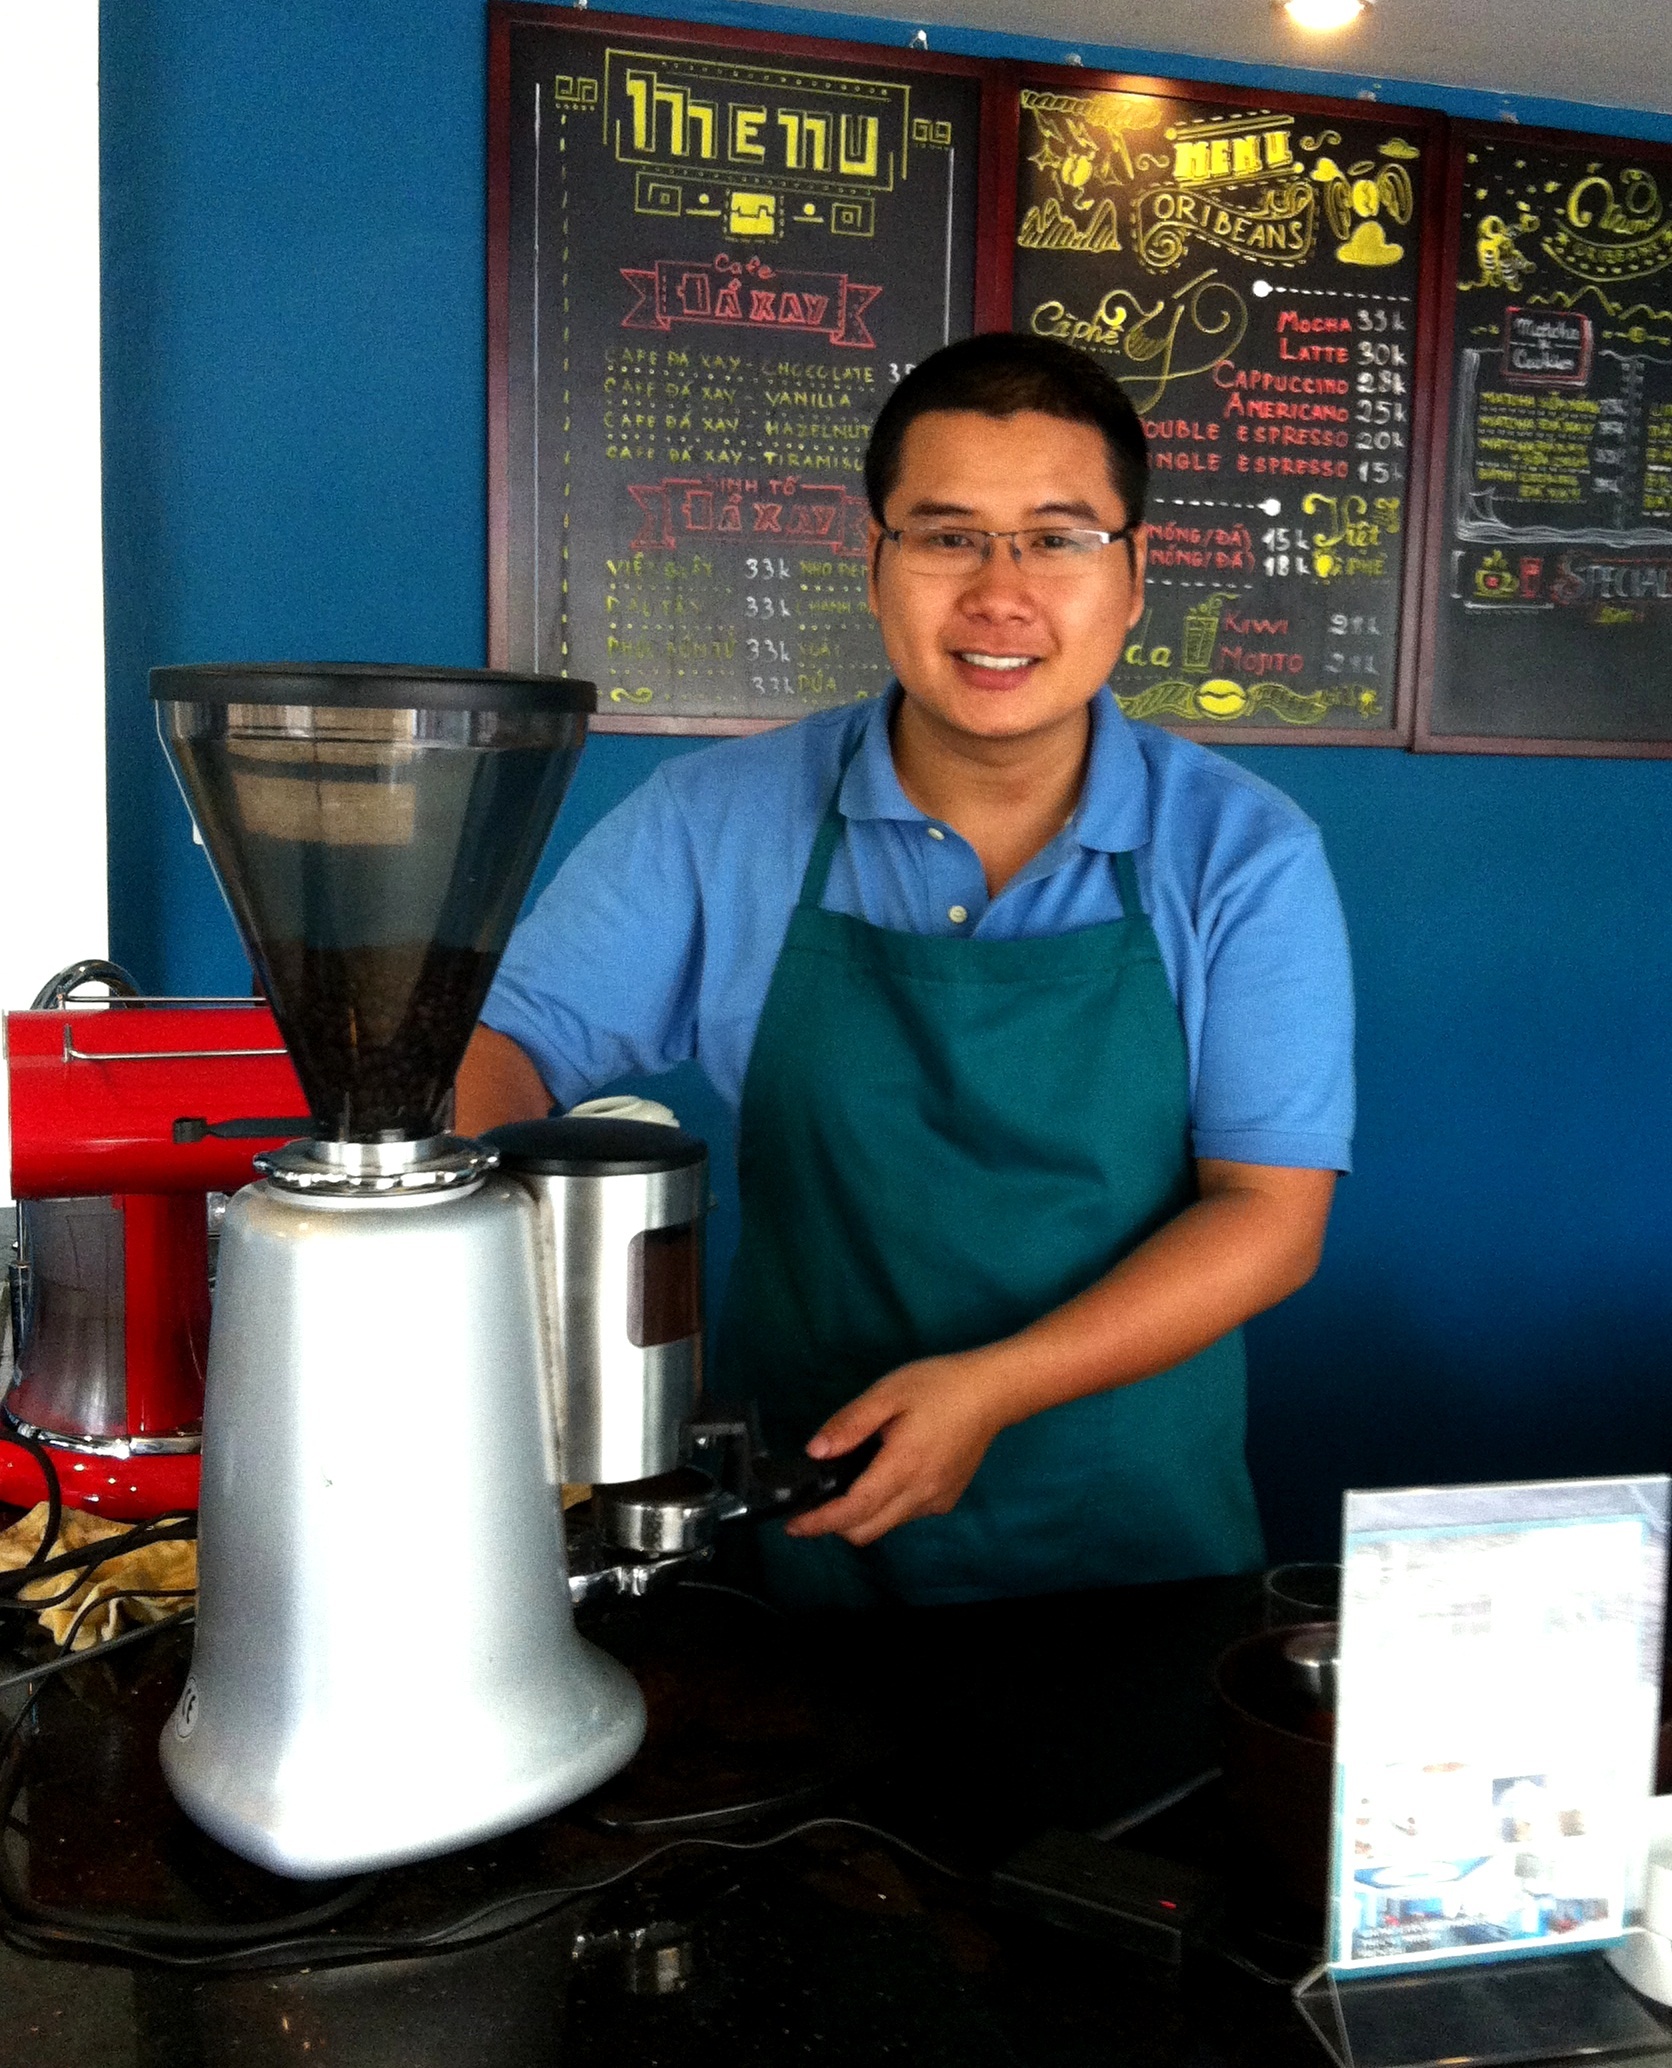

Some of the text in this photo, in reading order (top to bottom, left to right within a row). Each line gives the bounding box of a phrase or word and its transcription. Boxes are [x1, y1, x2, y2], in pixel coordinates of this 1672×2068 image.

[1174, 131, 1293, 181] MENU
[1154, 194, 1304, 250] ORIBEANS
[751, 290, 829, 326] XAY
[1357, 341, 1407, 366] 30k
[761, 360, 875, 383] CHOCOLATE
[702, 387, 736, 405] XAY
[765, 391, 850, 409] VANILLA
[1355, 399, 1406, 425] 25k
[702, 416, 739, 433] XAY
[765, 420, 870, 440] HAZELNUT
[1142, 419, 1220, 441] OUBLE
[1236, 424, 1348, 448] ESPRESSO
[705, 450, 742, 466] XAY
[1147, 451, 1221, 473] INGLE
[1237, 453, 1348, 478] ESPRESSO
[1262, 527, 1311, 552] 15k
[745, 558, 790, 580] 33k
[1263, 555, 1311, 577] 18k
[745, 596, 791, 620] 33k
[745, 638, 791, 662] 33k
